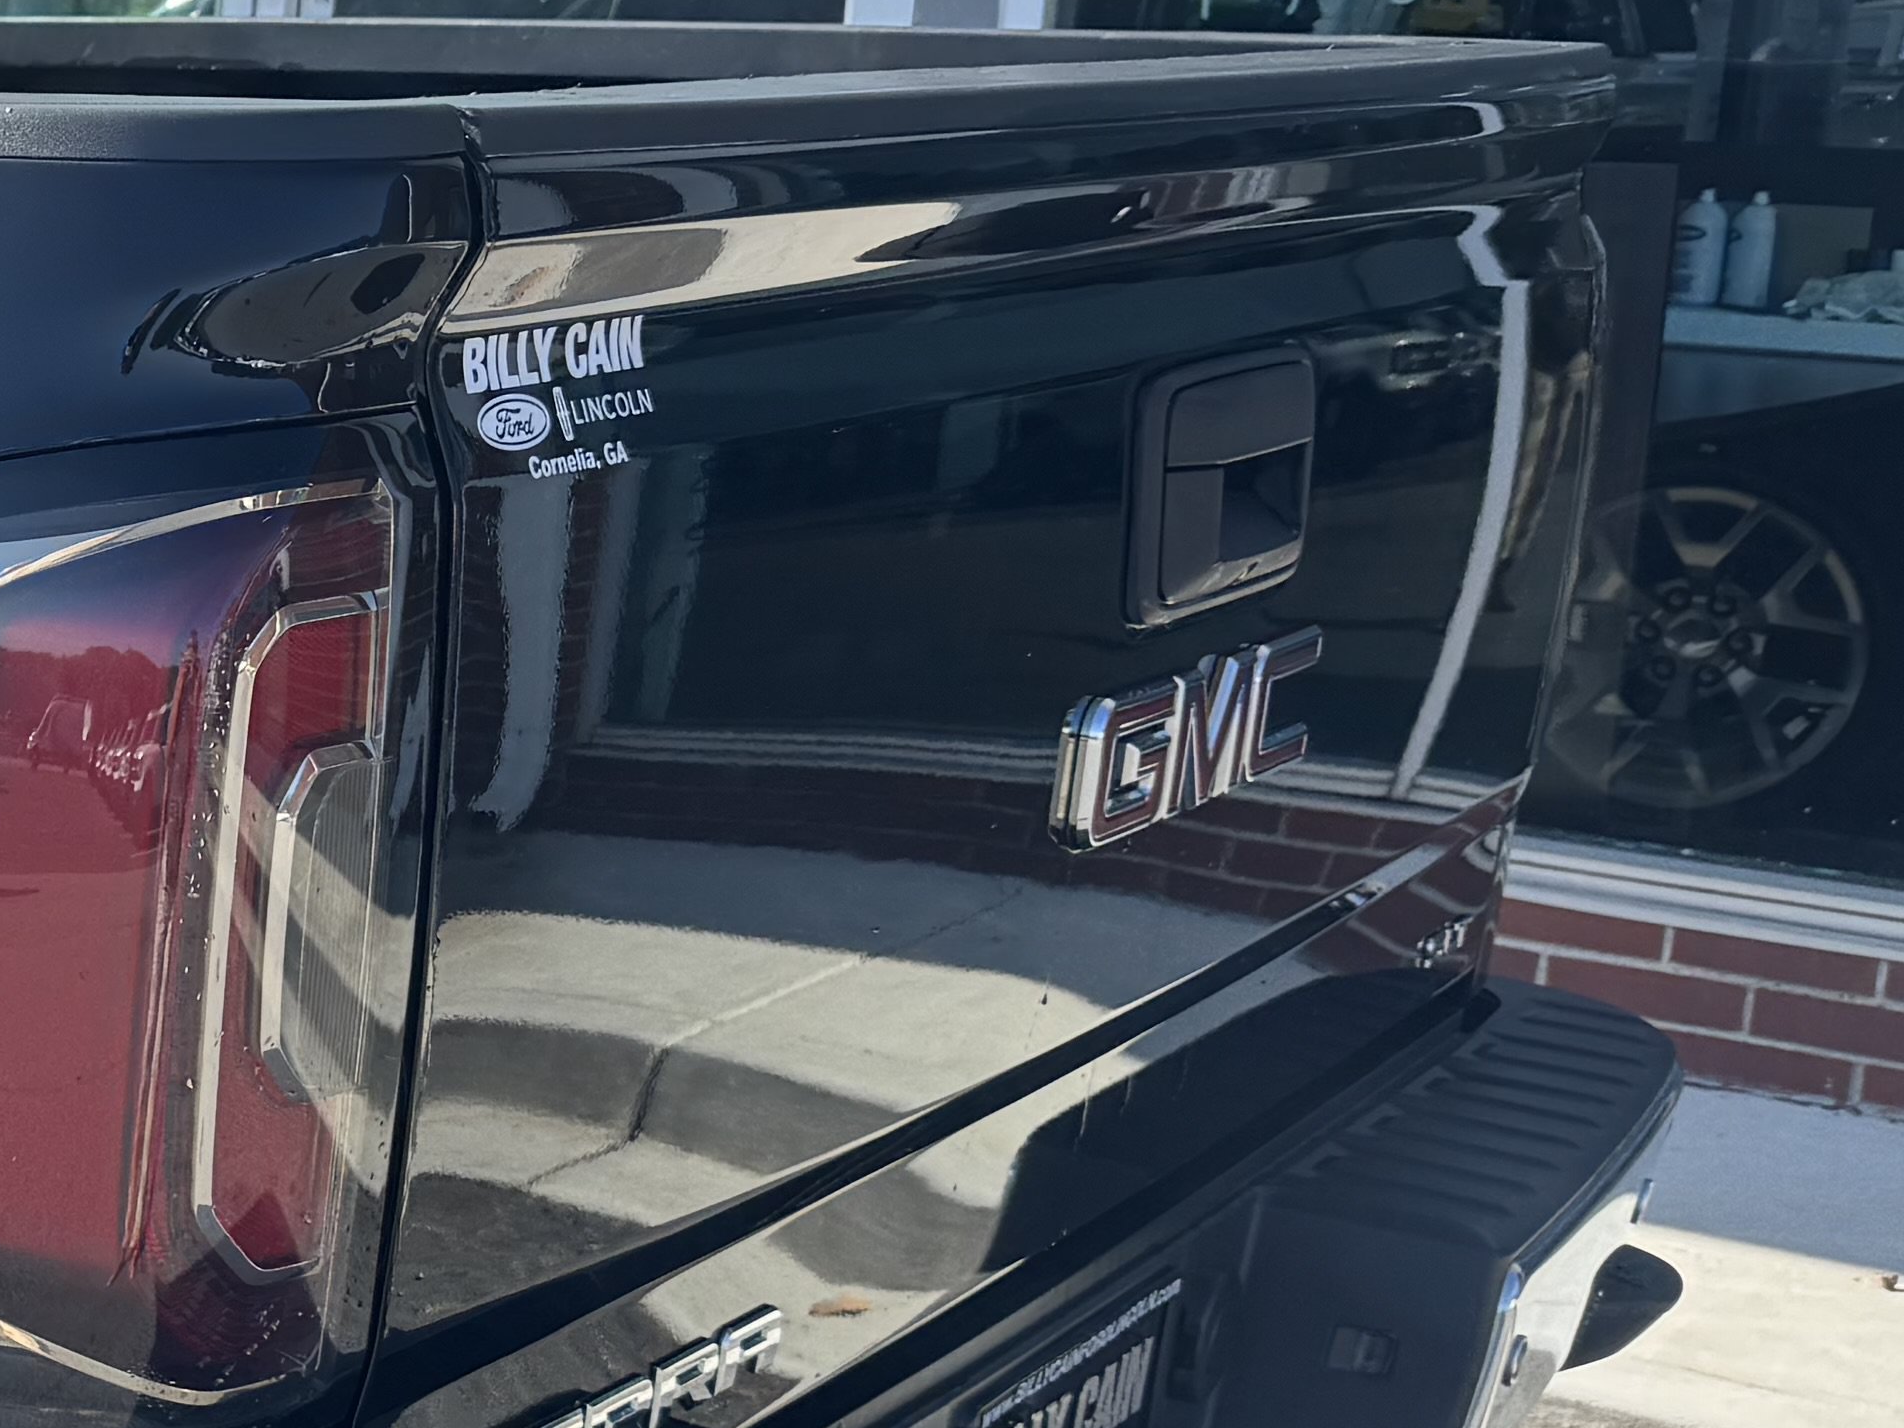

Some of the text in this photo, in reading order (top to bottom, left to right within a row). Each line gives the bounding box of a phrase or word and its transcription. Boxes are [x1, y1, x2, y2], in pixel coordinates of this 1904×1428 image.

[462, 314, 645, 395] BILLY CAIN
[495, 407, 535, 441] Ford
[568, 387, 655, 426] LINCOLN
[528, 440, 630, 480] Cornelia, GA
[1049, 624, 1324, 854] GMC
